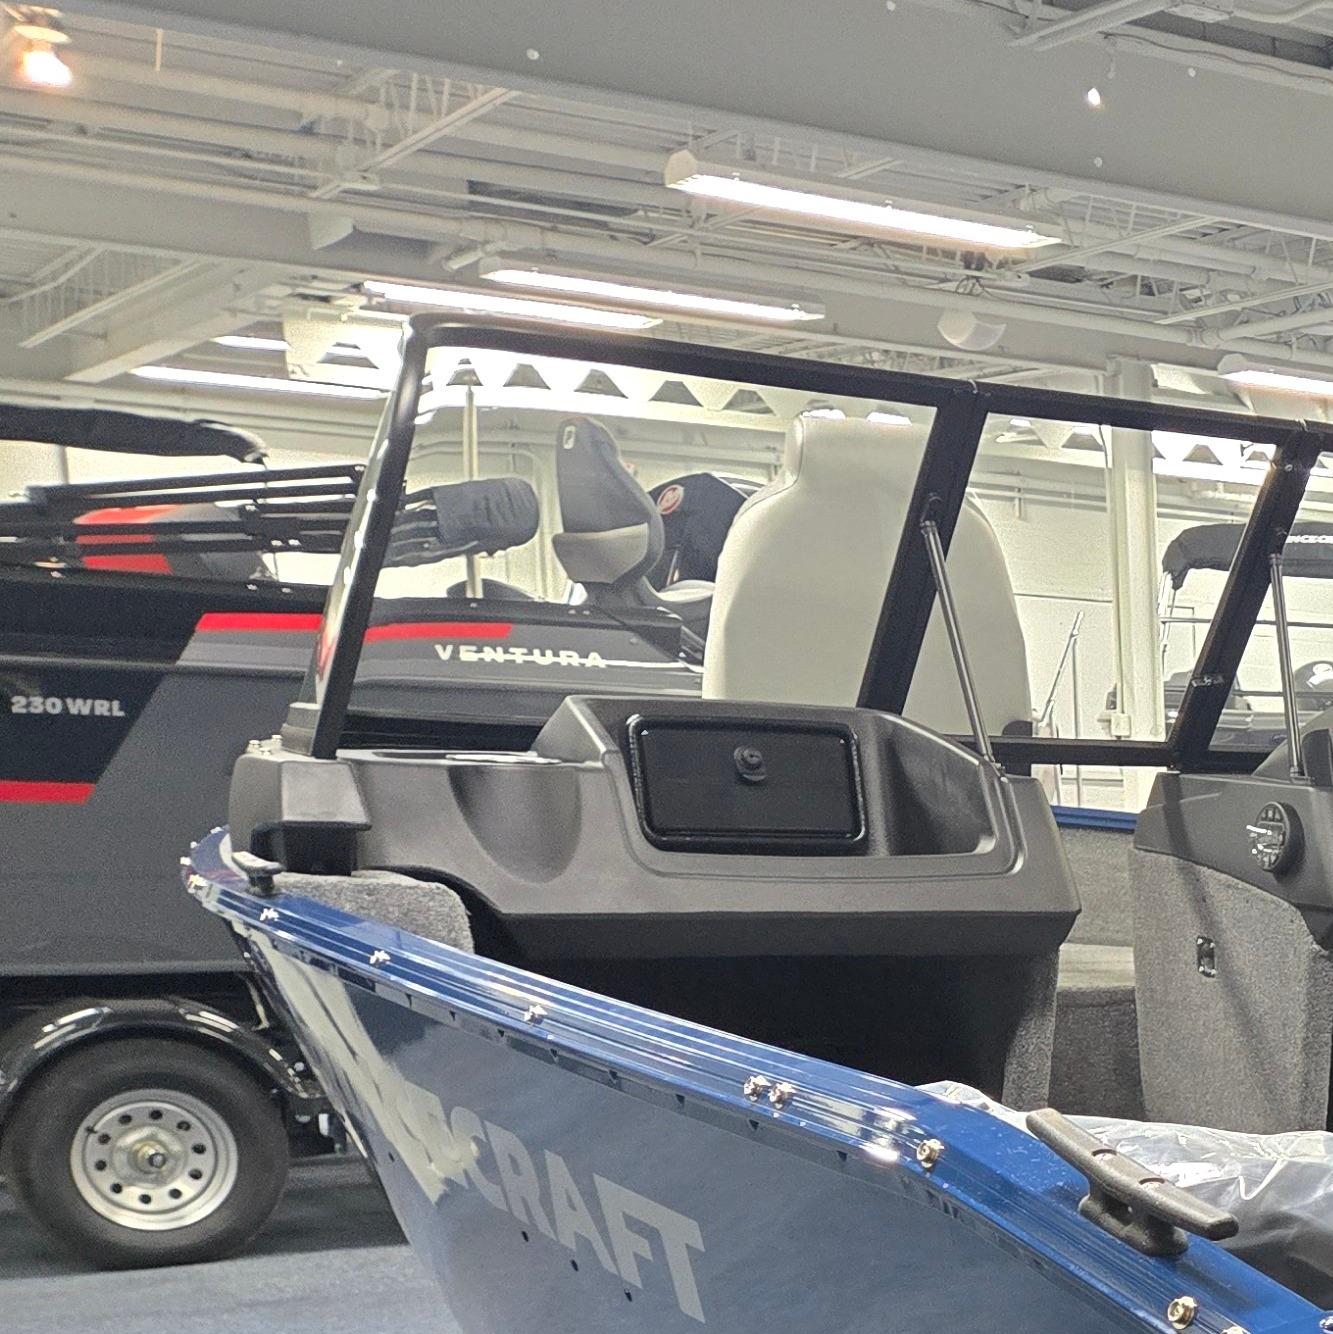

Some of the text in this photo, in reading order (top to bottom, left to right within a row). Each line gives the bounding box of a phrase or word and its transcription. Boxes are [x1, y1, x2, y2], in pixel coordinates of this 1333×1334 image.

[434, 645, 607, 668] VENTURA
[11, 696, 125, 716] 230 WRL
